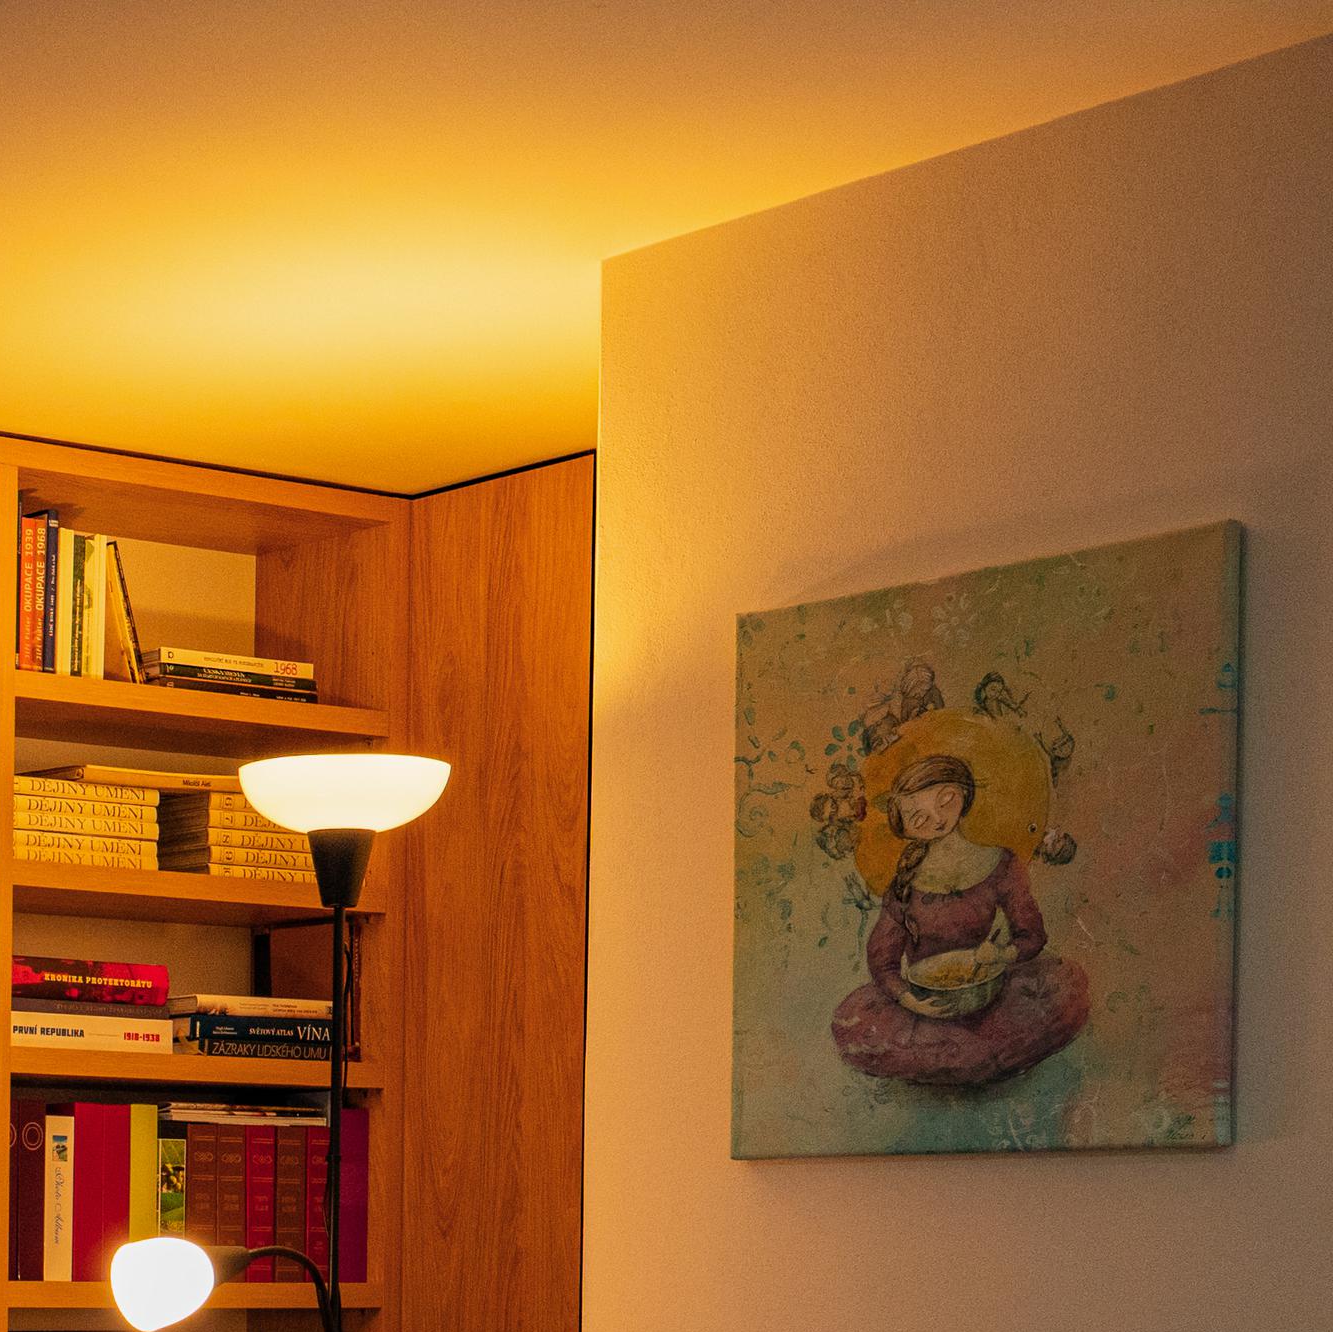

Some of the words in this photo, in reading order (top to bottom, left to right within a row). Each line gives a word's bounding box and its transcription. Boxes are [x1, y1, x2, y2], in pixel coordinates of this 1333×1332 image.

[24, 528, 33, 556] 1939
[37, 527, 46, 555] 1968
[24, 562, 33, 612] OKUPACE
[36, 562, 45, 611] OKUPACE
[273, 662, 298, 676] 1968
[30, 776, 89, 797] DĚJINY
[93, 784, 146, 801] UMĚNÍ
[27, 797, 86, 816] DĚJINY
[91, 802, 144, 820] UMĚNÍ
[27, 813, 86, 832] DĚJINY
[92, 818, 145, 835] UMĚNÍ
[26, 832, 84, 851] DĚJINY
[90, 839, 143, 857] UMĚNÍ
[44, 973, 83, 984] KRONIKA
[86, 975, 152, 989] PROTEKTORÁTU
[13, 1025, 38, 1036] PRVNÍ
[40, 1027, 85, 1038] REPUBLIKA
[123, 1032, 160, 1042] 1918-1938
[297, 1026, 331, 1041] VÍNA
[211, 1041, 255, 1056] ZÁZRAKY
[257, 1042, 304, 1059] LIDSKÉHO
[305, 1043, 327, 1060] UMU
